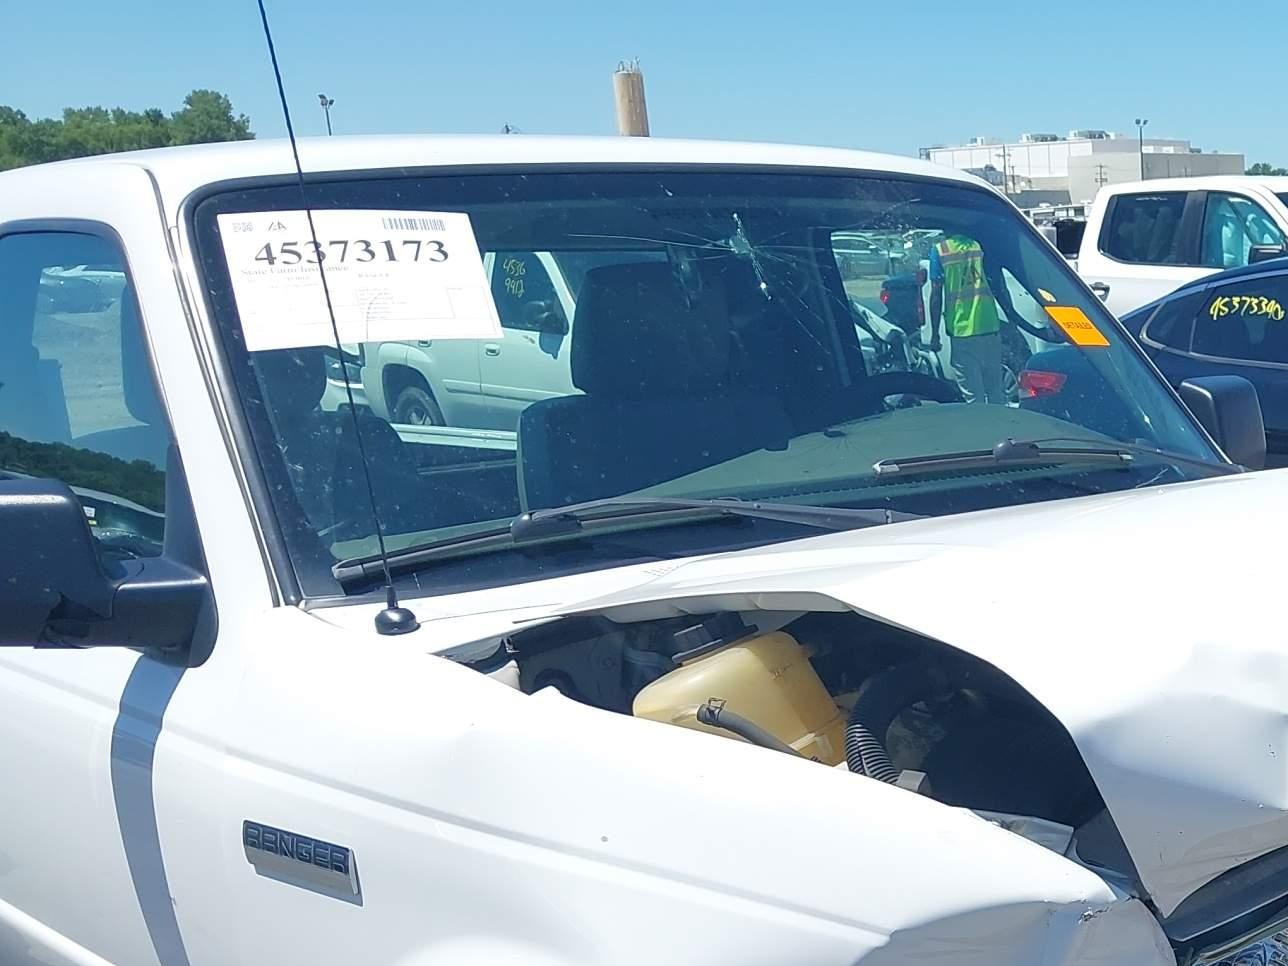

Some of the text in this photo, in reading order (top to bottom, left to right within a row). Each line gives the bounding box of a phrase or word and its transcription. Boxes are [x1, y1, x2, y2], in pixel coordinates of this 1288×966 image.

[254, 239, 449, 266] 45373173
[300, 264, 349, 273] Insuance
[244, 826, 350, 875] RANGER
